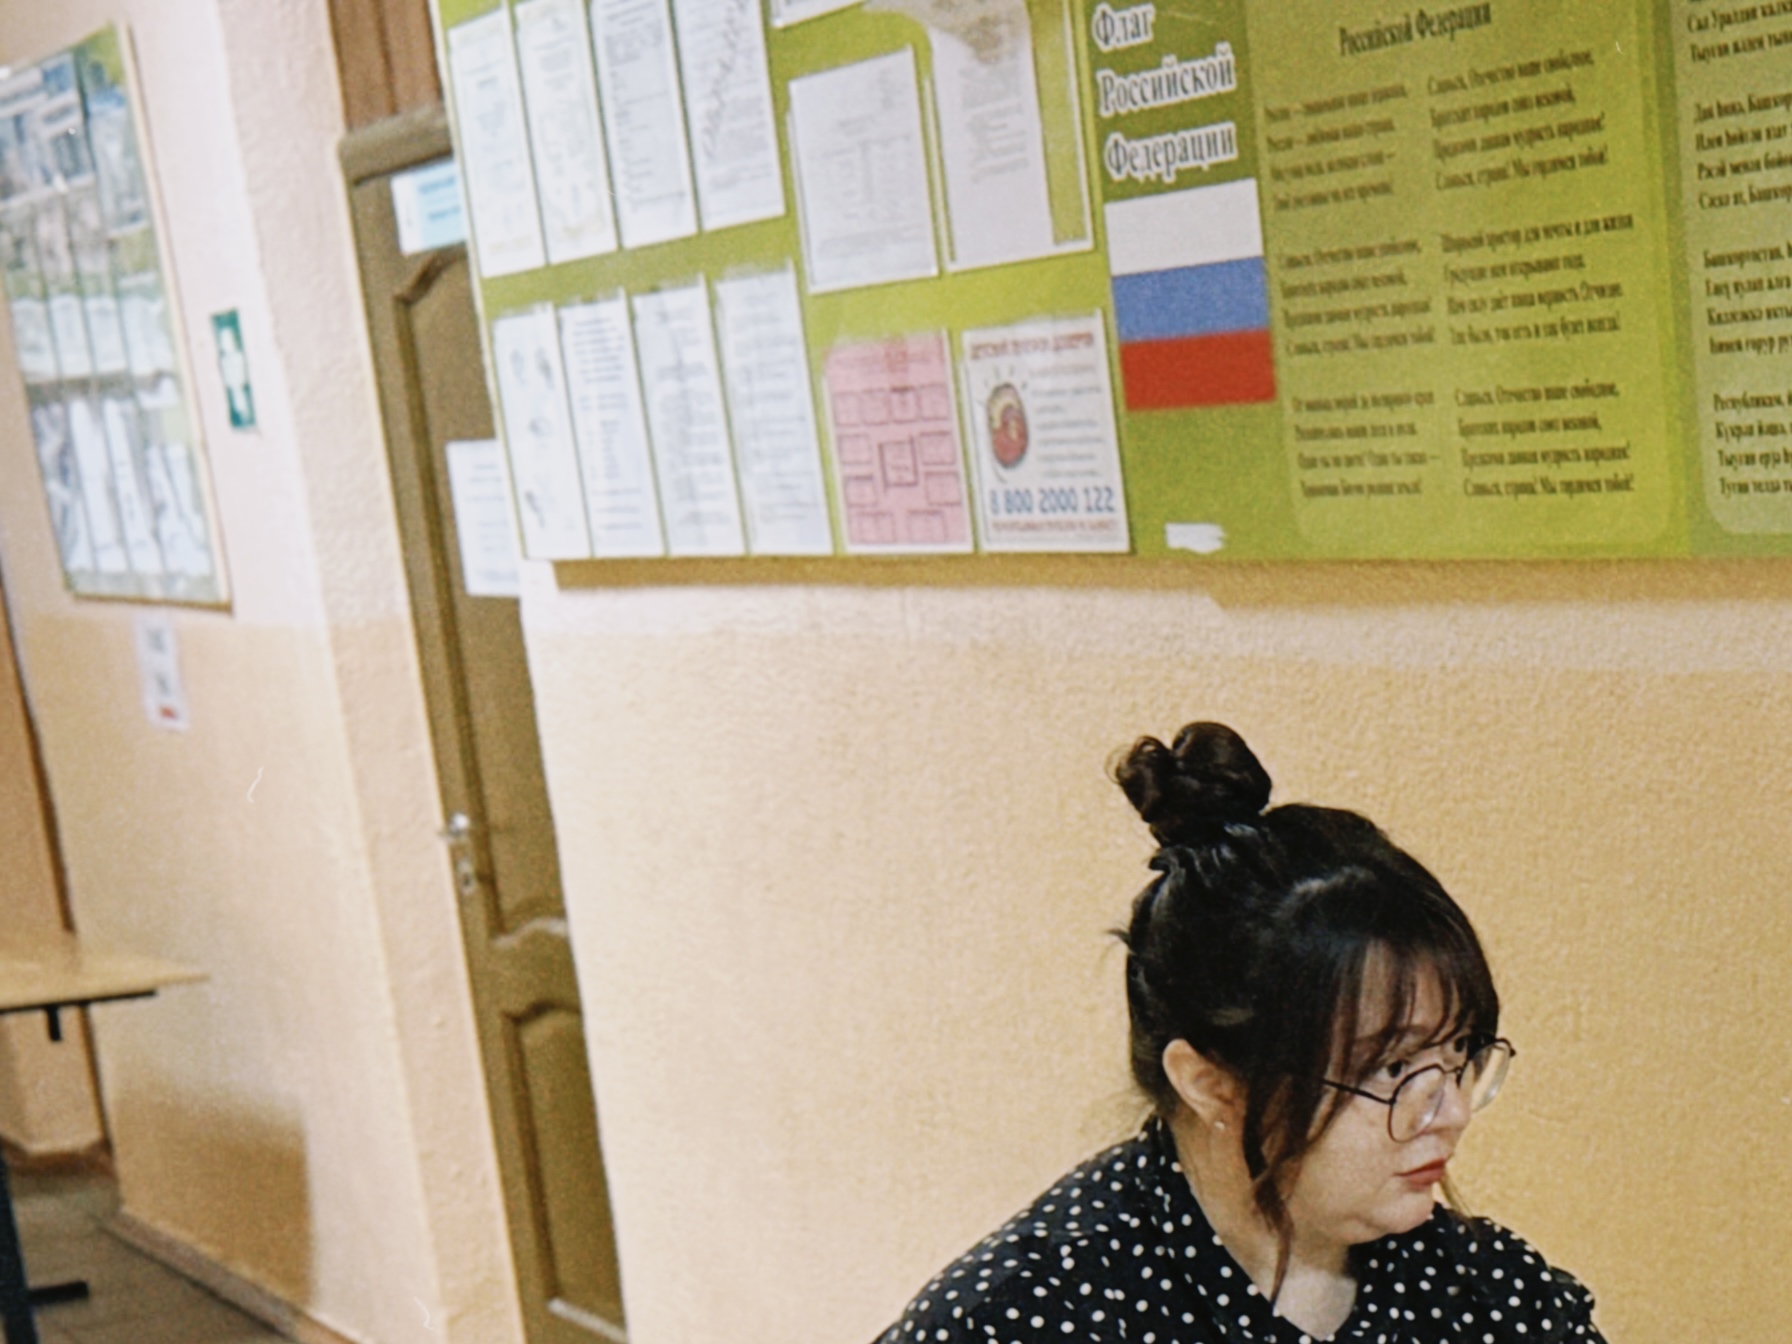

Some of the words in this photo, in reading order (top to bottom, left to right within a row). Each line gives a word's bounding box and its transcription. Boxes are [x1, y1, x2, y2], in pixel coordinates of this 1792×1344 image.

[1094, 7, 1152, 48] Флаг
[1100, 45, 1235, 114] Российской
[1107, 126, 1236, 180] Федерации
[1039, 487, 1078, 514] 2000
[1083, 487, 1115, 513] 122
